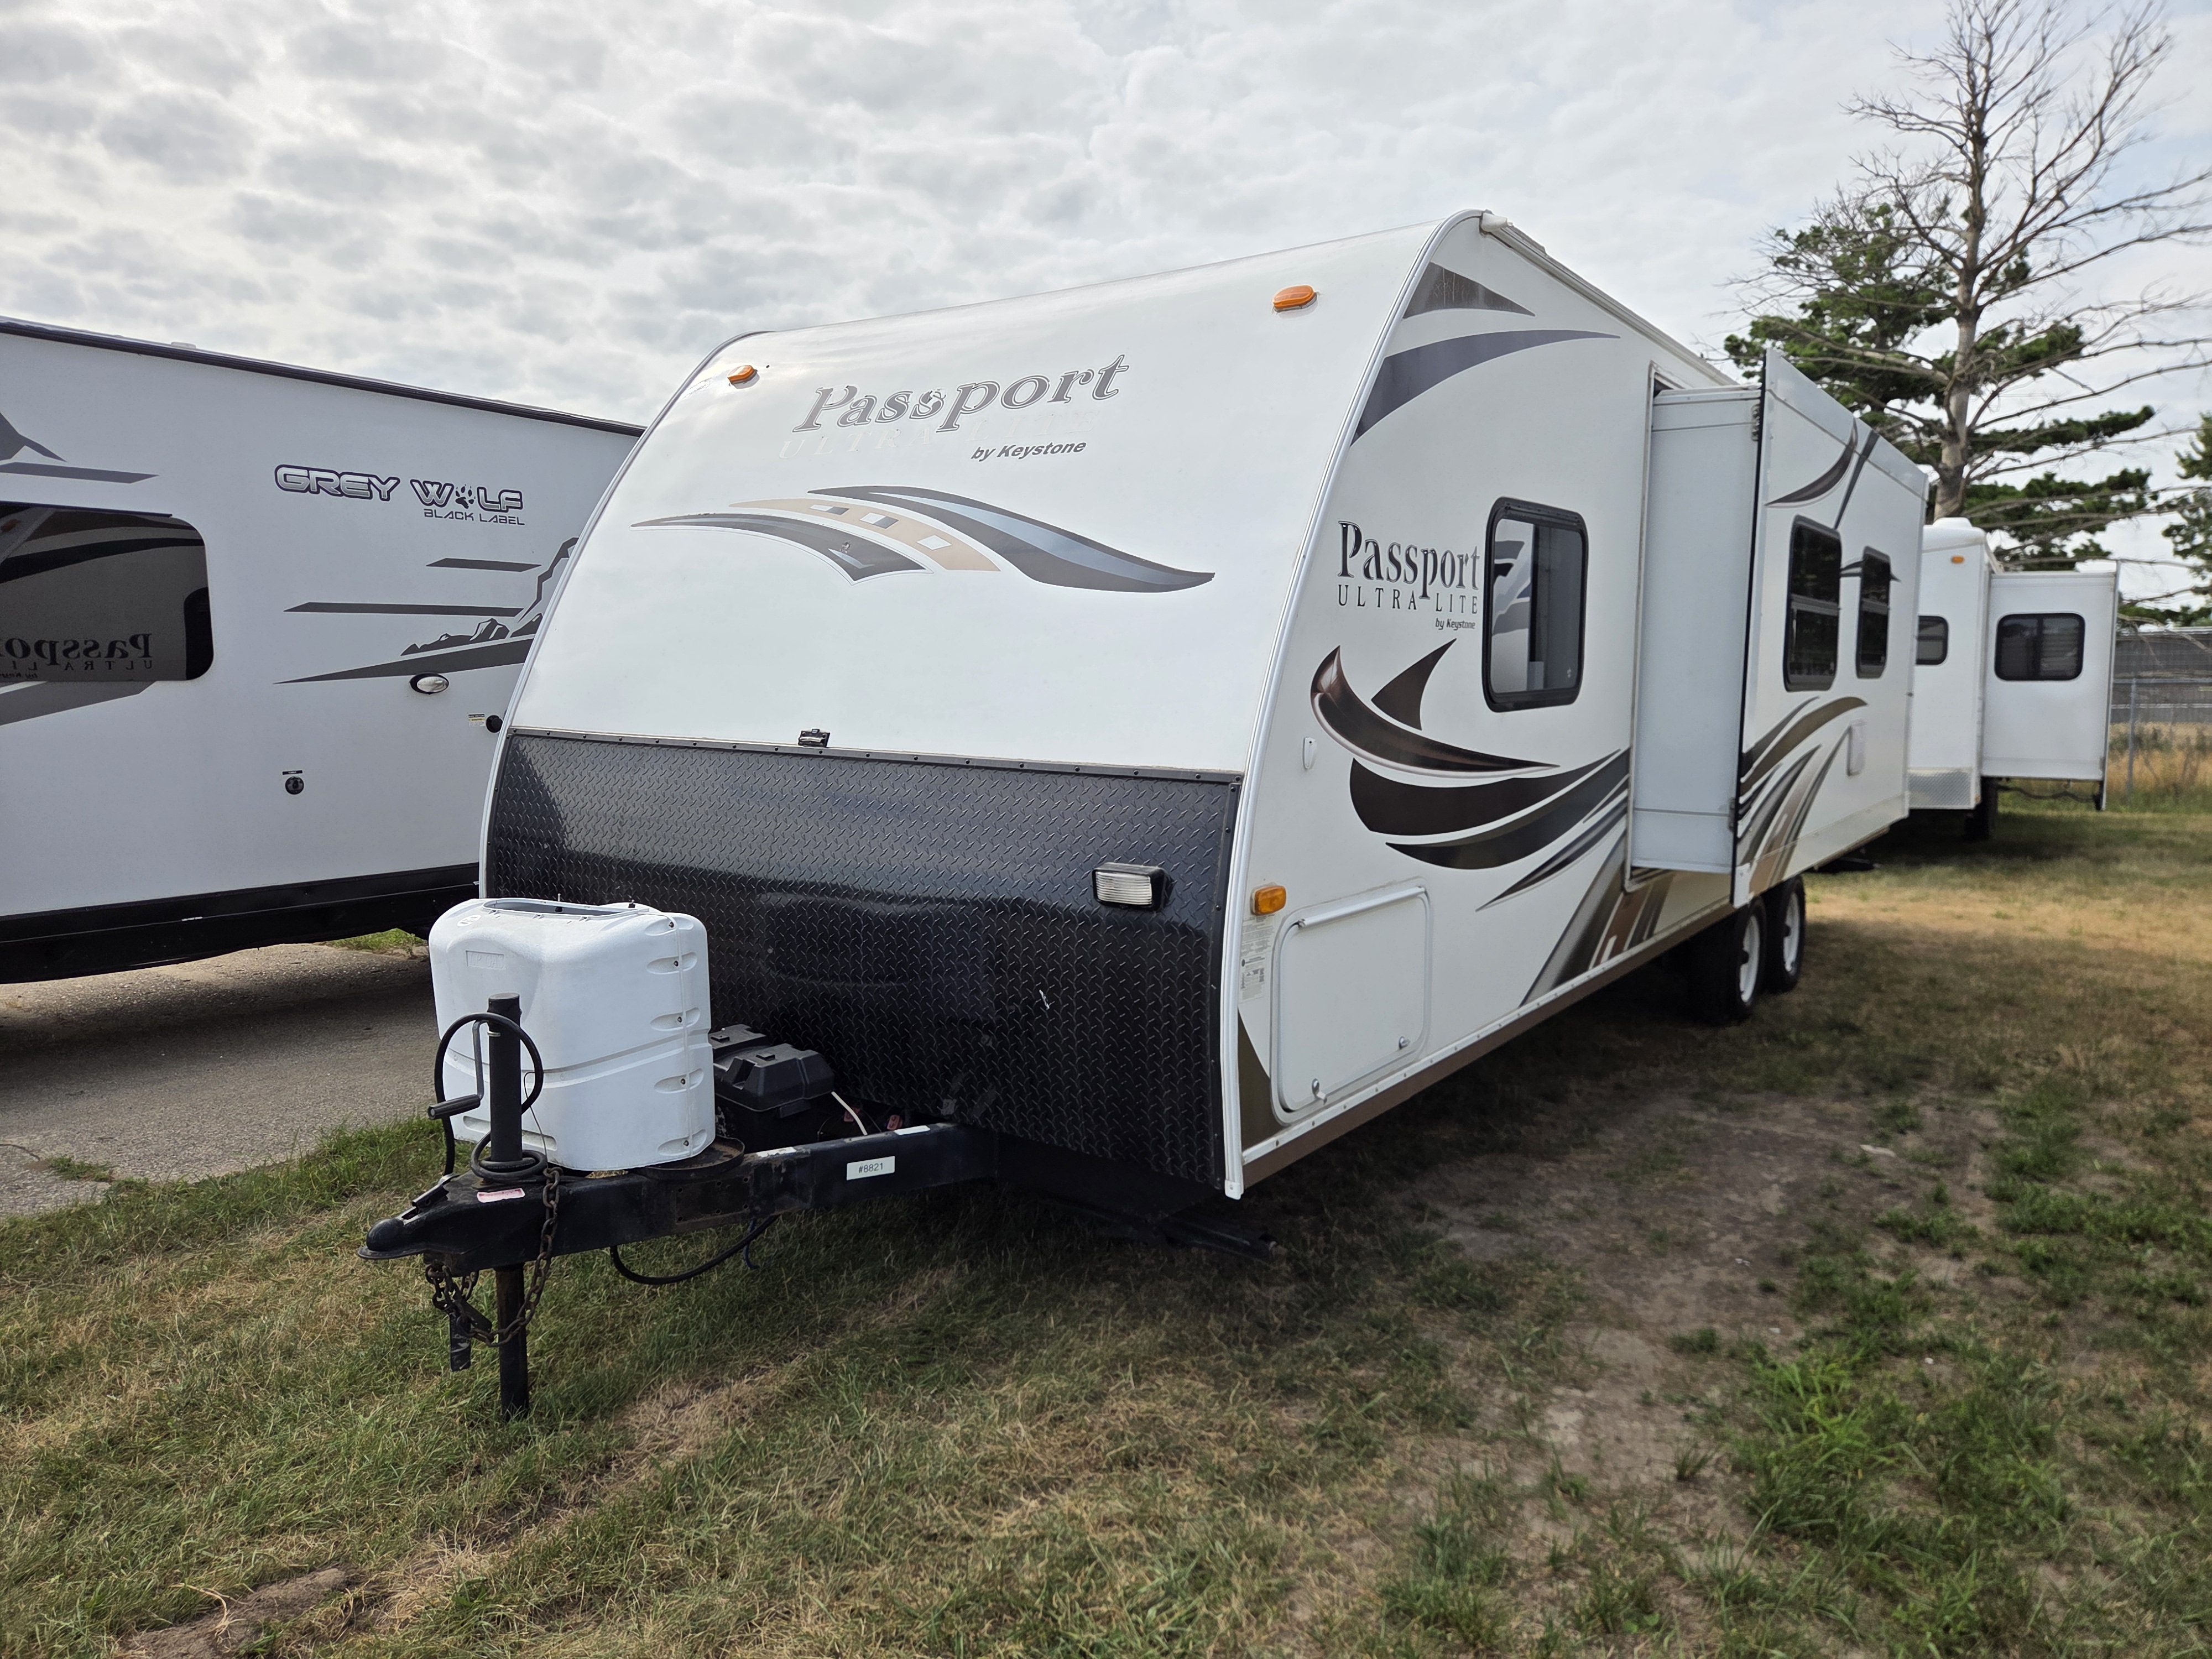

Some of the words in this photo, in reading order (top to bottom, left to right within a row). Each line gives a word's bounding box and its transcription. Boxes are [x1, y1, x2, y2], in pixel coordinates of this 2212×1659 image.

[792, 354, 1129, 432] Passport
[779, 426, 932, 458] ULTRA
[971, 446, 996, 462] by
[997, 442, 1086, 460] Keystone
[275, 465, 400, 501] GREY
[424, 508, 474, 521] BLACK
[479, 513, 525, 525] LABEL
[1337, 520, 1480, 599] Passport
[1338, 585, 1417, 610] ULTRA
[1436, 593, 1478, 614] LITE
[1435, 618, 1445, 630] by
[1446, 618, 1475, 630] Keystone
[858, 1162, 883, 1174] #8821
